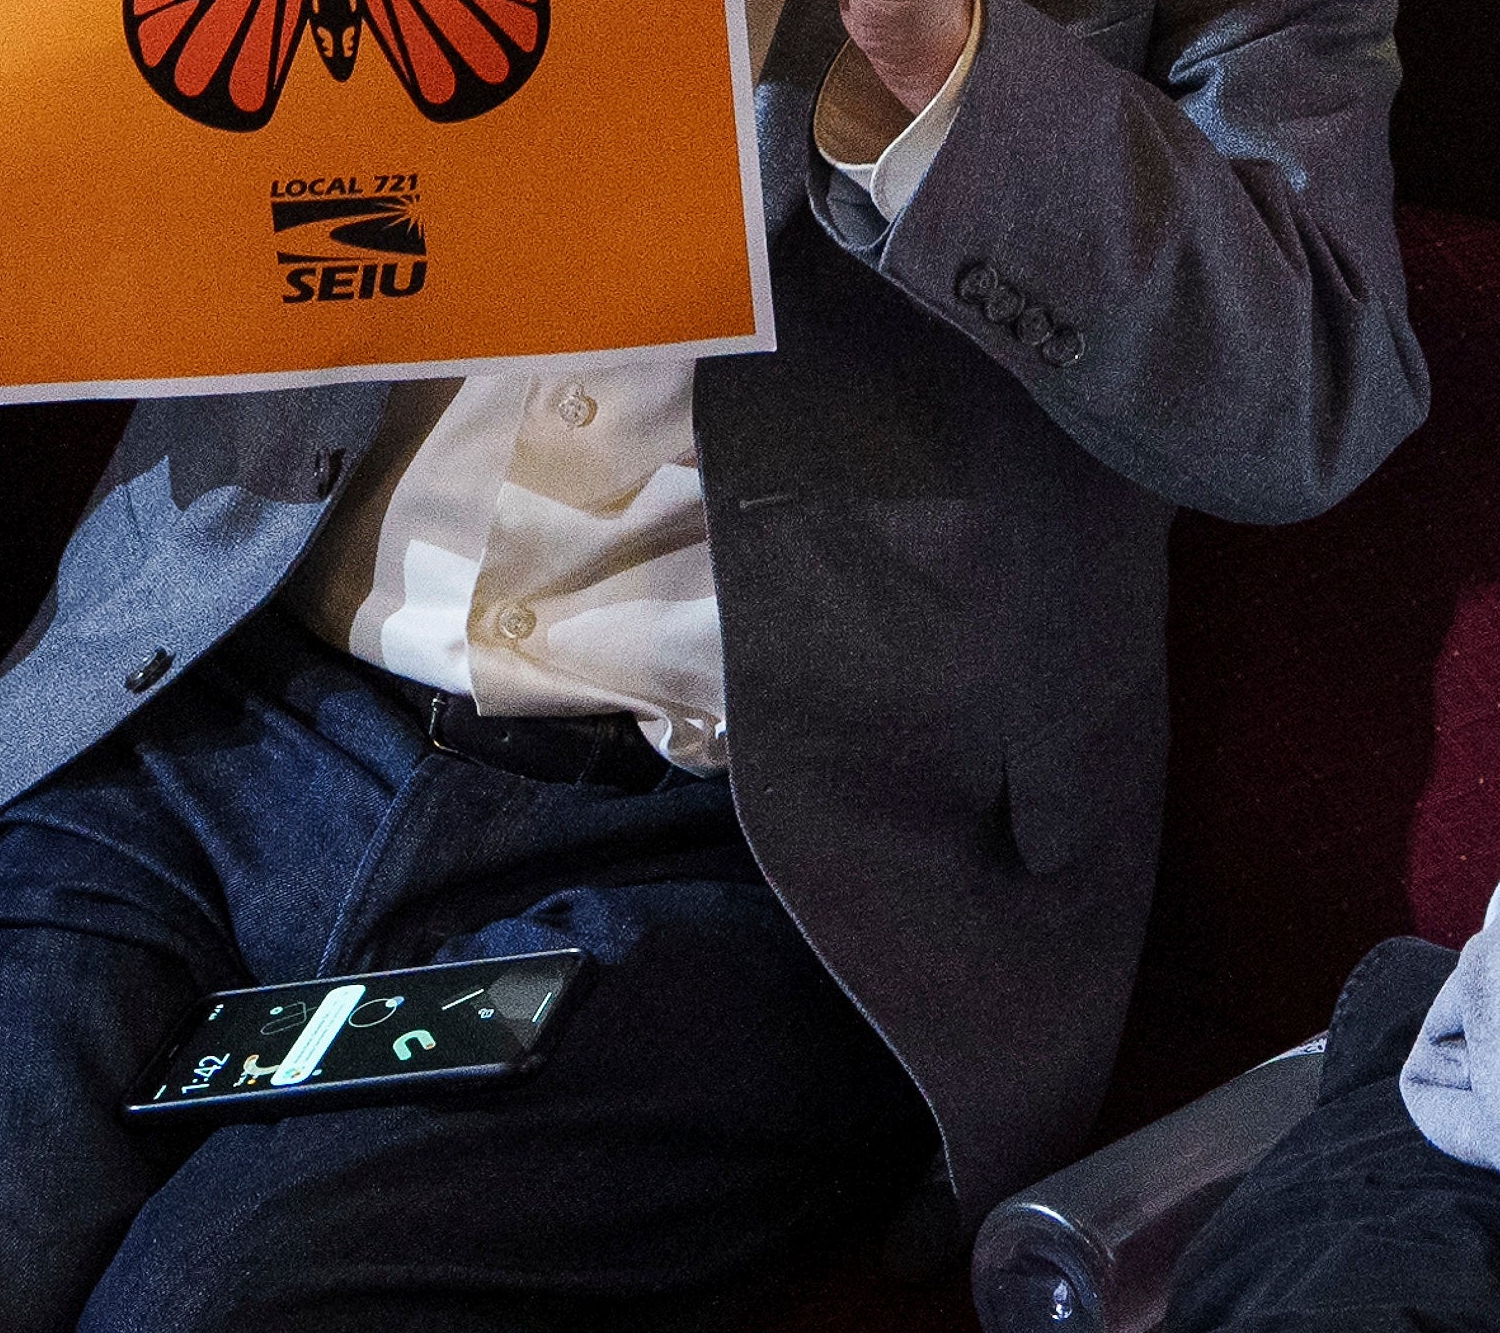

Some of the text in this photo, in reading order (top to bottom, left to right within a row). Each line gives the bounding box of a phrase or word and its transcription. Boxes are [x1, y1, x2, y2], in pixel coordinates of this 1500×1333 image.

[270, 174, 418, 198] LOCAL 721
[283, 261, 428, 304] SEIU
[181, 1052, 231, 1095] 1:42
